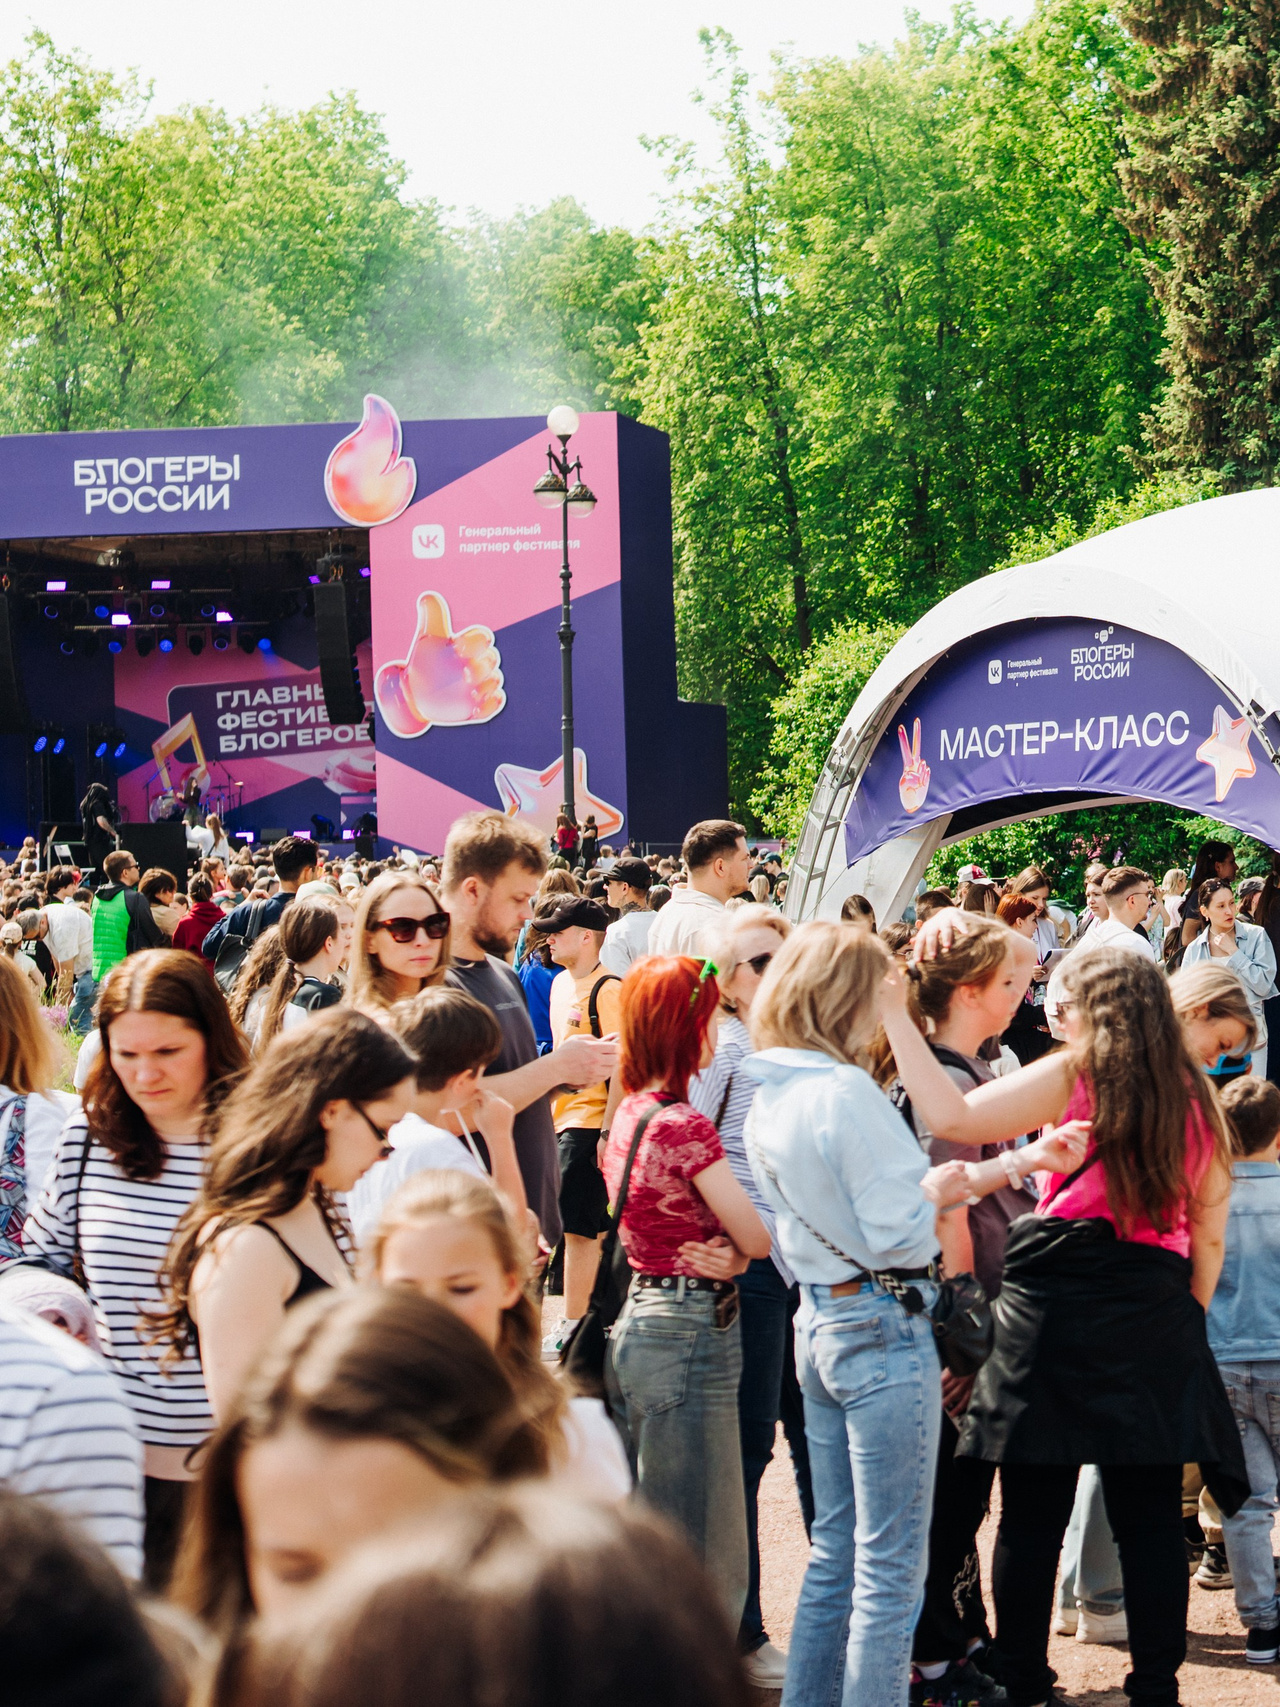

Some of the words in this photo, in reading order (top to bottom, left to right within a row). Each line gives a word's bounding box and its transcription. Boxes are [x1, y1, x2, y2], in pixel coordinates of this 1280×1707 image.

[74, 454, 240, 486] БЛОГЕРЫ
[85, 484, 230, 515] РОССИИ
[459, 523, 542, 539] Генеральный
[459, 541, 510, 556] партнер
[1007, 656, 1043, 669] Генеральный
[1071, 643, 1135, 664] БЛОГЕРЫ
[1074, 661, 1130, 682] РОССИИ
[939, 710, 1190, 761] МАСТЕР-КЛАСС
